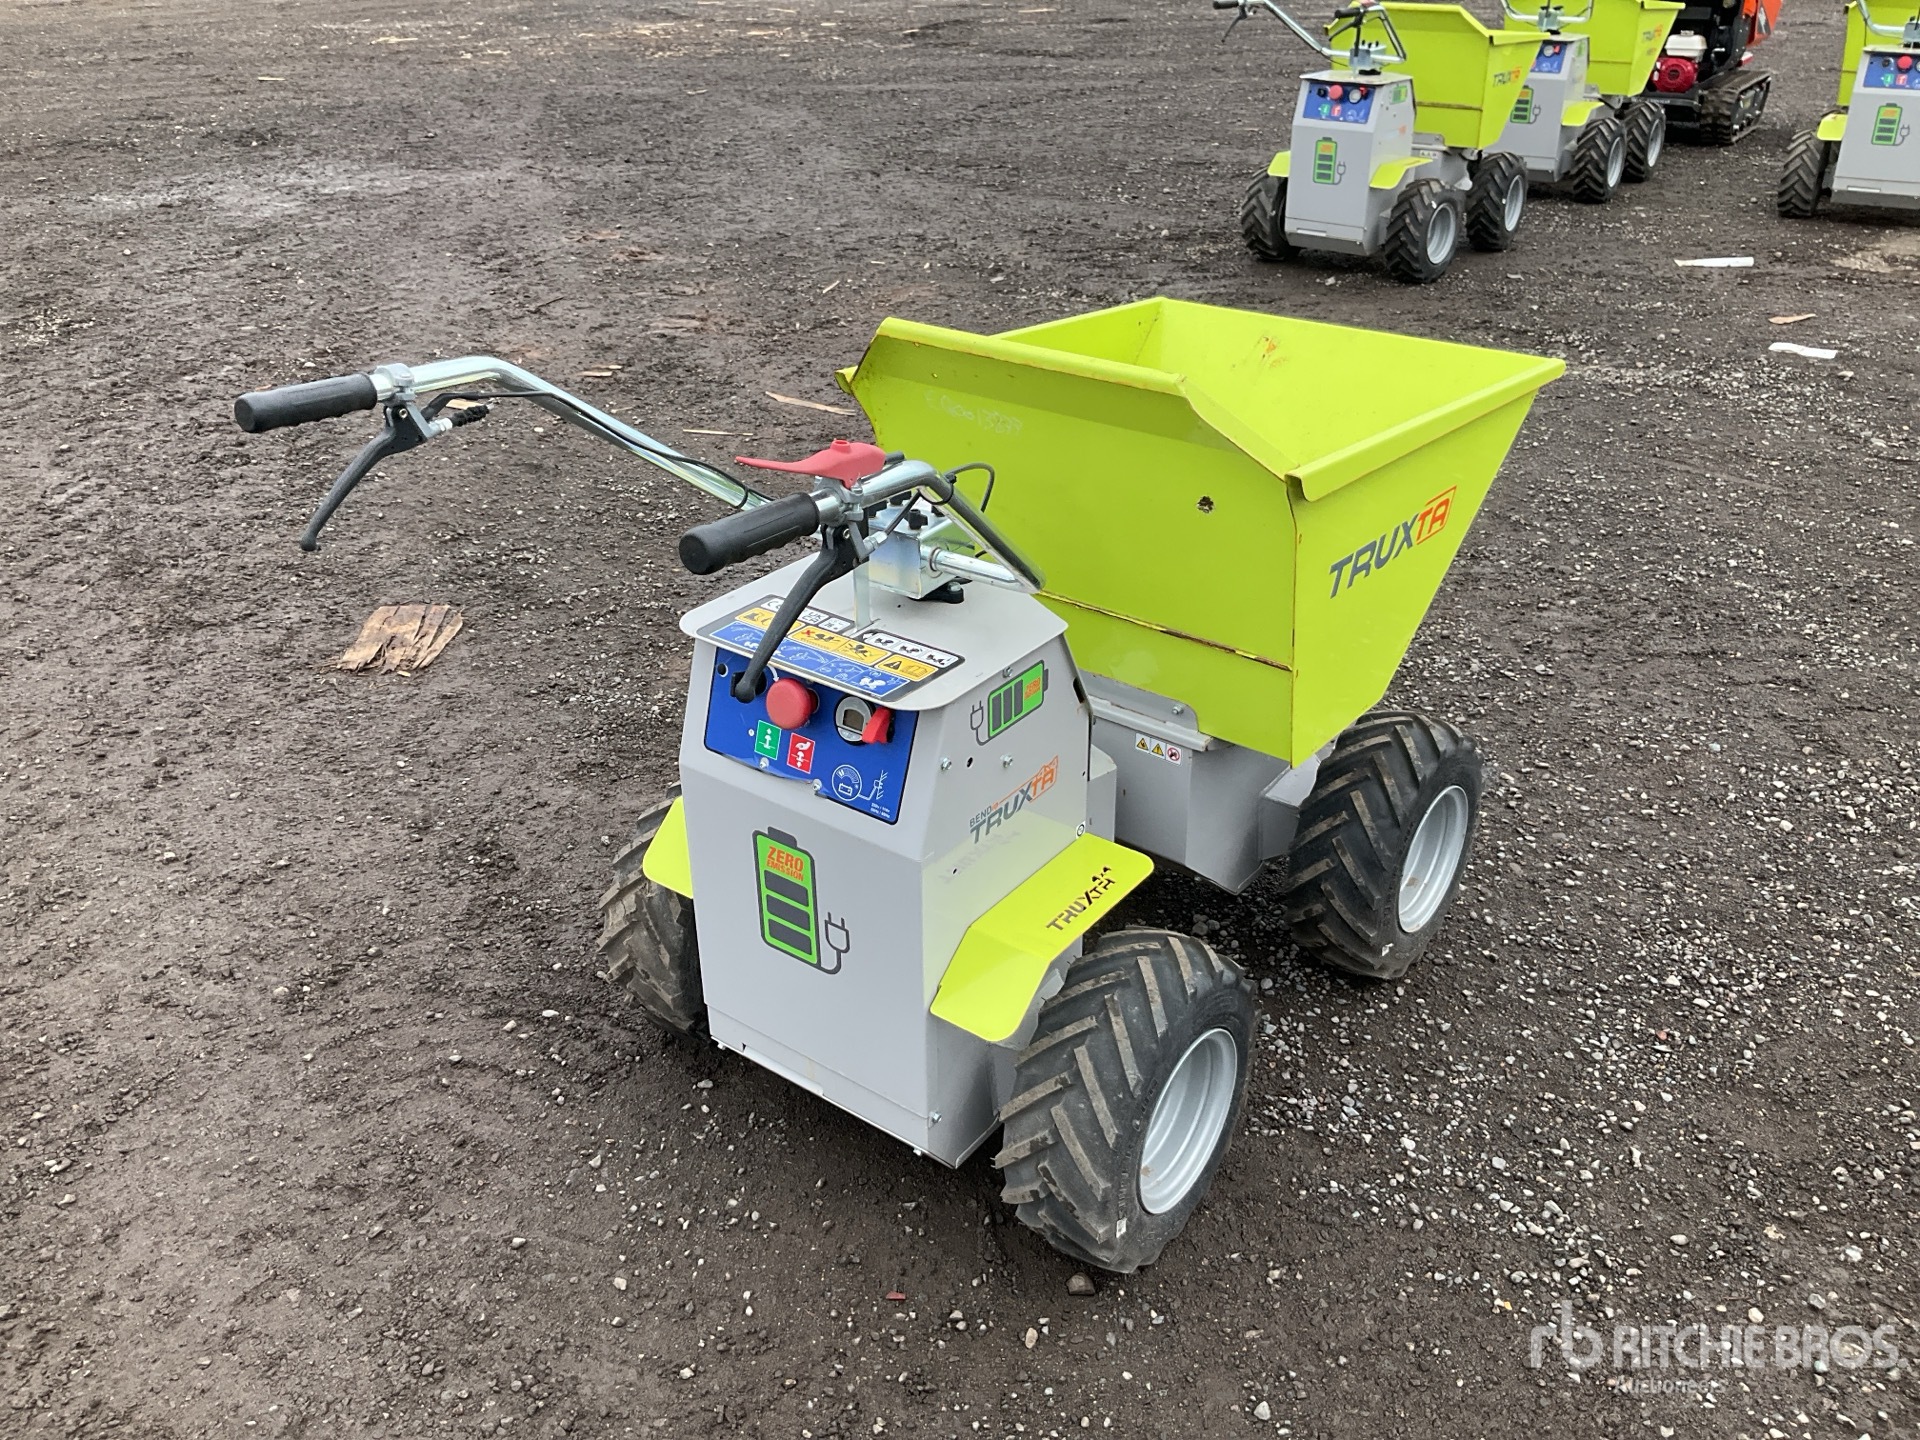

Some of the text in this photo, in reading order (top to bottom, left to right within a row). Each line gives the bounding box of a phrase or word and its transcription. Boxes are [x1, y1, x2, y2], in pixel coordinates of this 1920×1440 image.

[1329, 497, 1451, 599] TRUXTA
[970, 767, 1055, 844] TRUXTA
[766, 859, 804, 882] EMISSION
[767, 845, 804, 872] ZERO
